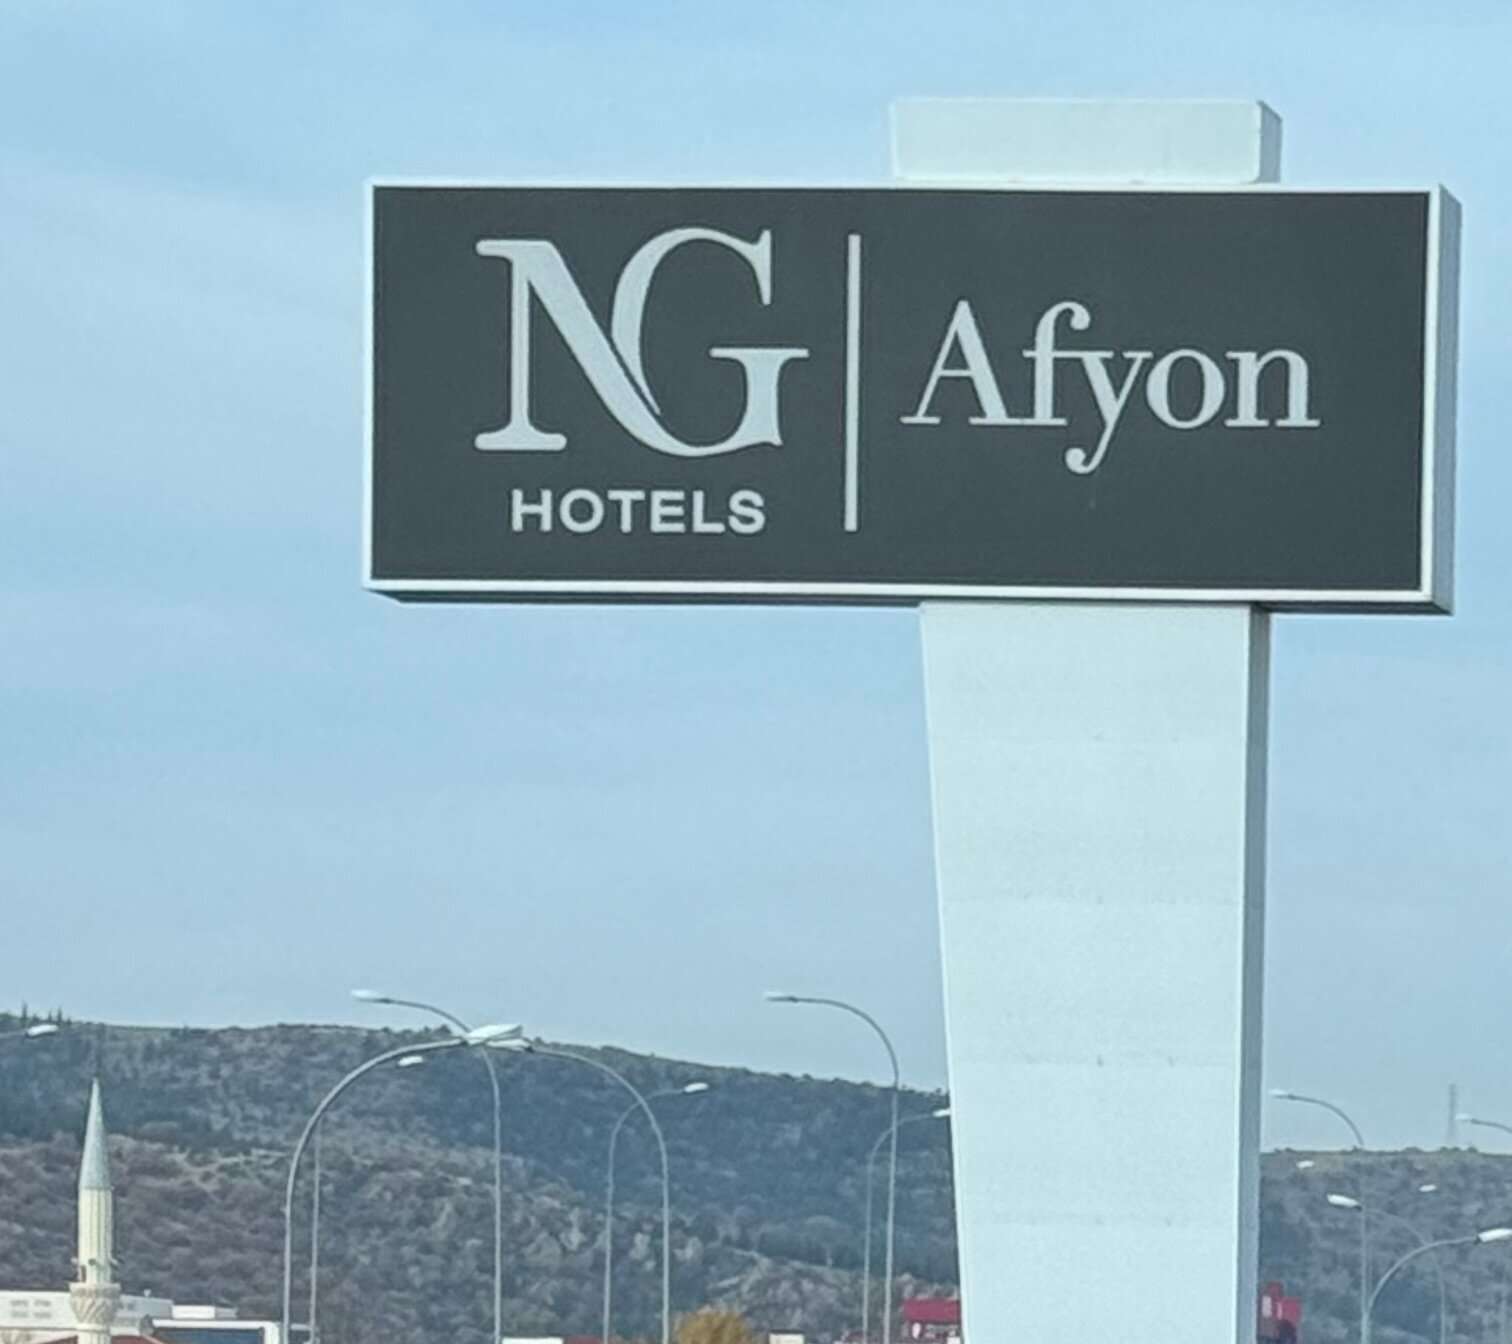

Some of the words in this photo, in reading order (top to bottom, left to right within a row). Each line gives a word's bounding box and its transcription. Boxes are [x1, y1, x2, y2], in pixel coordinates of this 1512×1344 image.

[475, 228, 810, 457] NG
[901, 301, 1320, 474] Afyon
[511, 489, 766, 534] HOTELS
